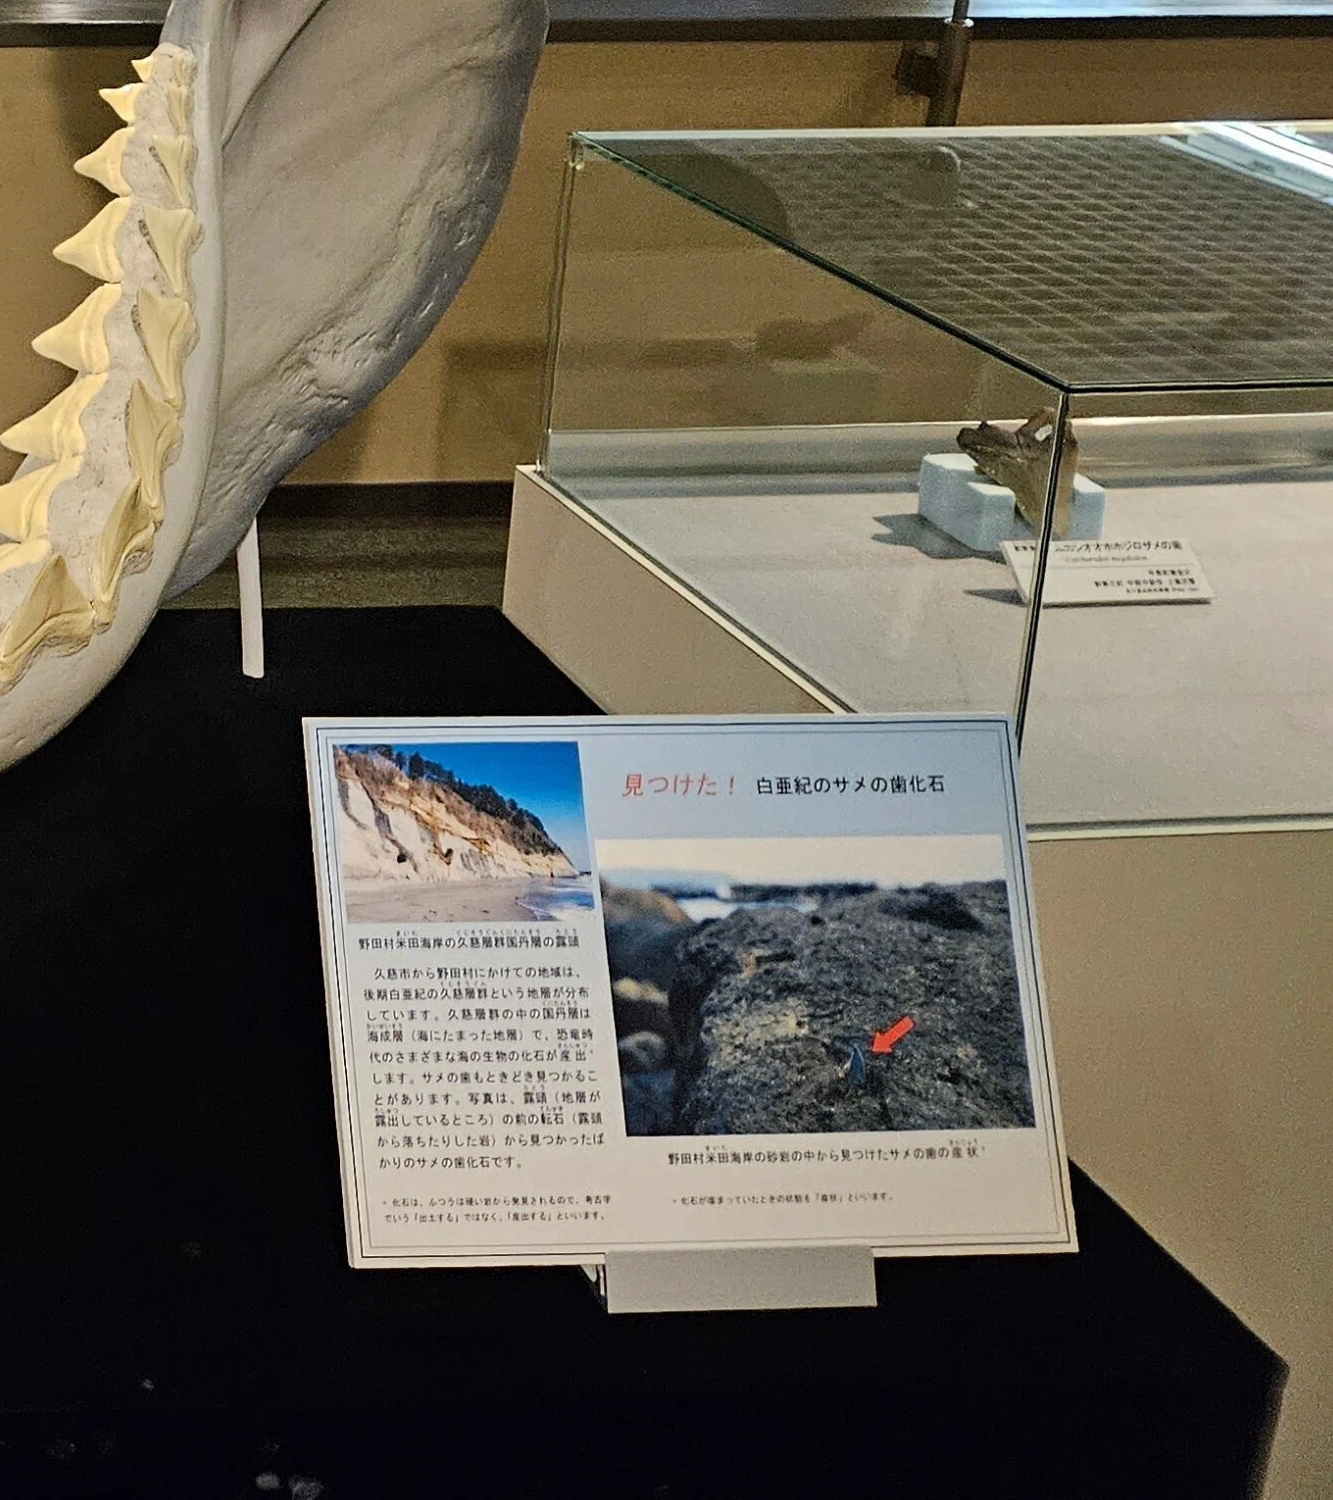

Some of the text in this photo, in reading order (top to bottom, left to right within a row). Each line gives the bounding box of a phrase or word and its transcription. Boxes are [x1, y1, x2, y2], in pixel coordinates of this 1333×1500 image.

[622, 773, 945, 797] 見つけた！ 白亜紀のサメの歯化石
[379, 1156, 522, 1169] かりのサメの歯化石です。
